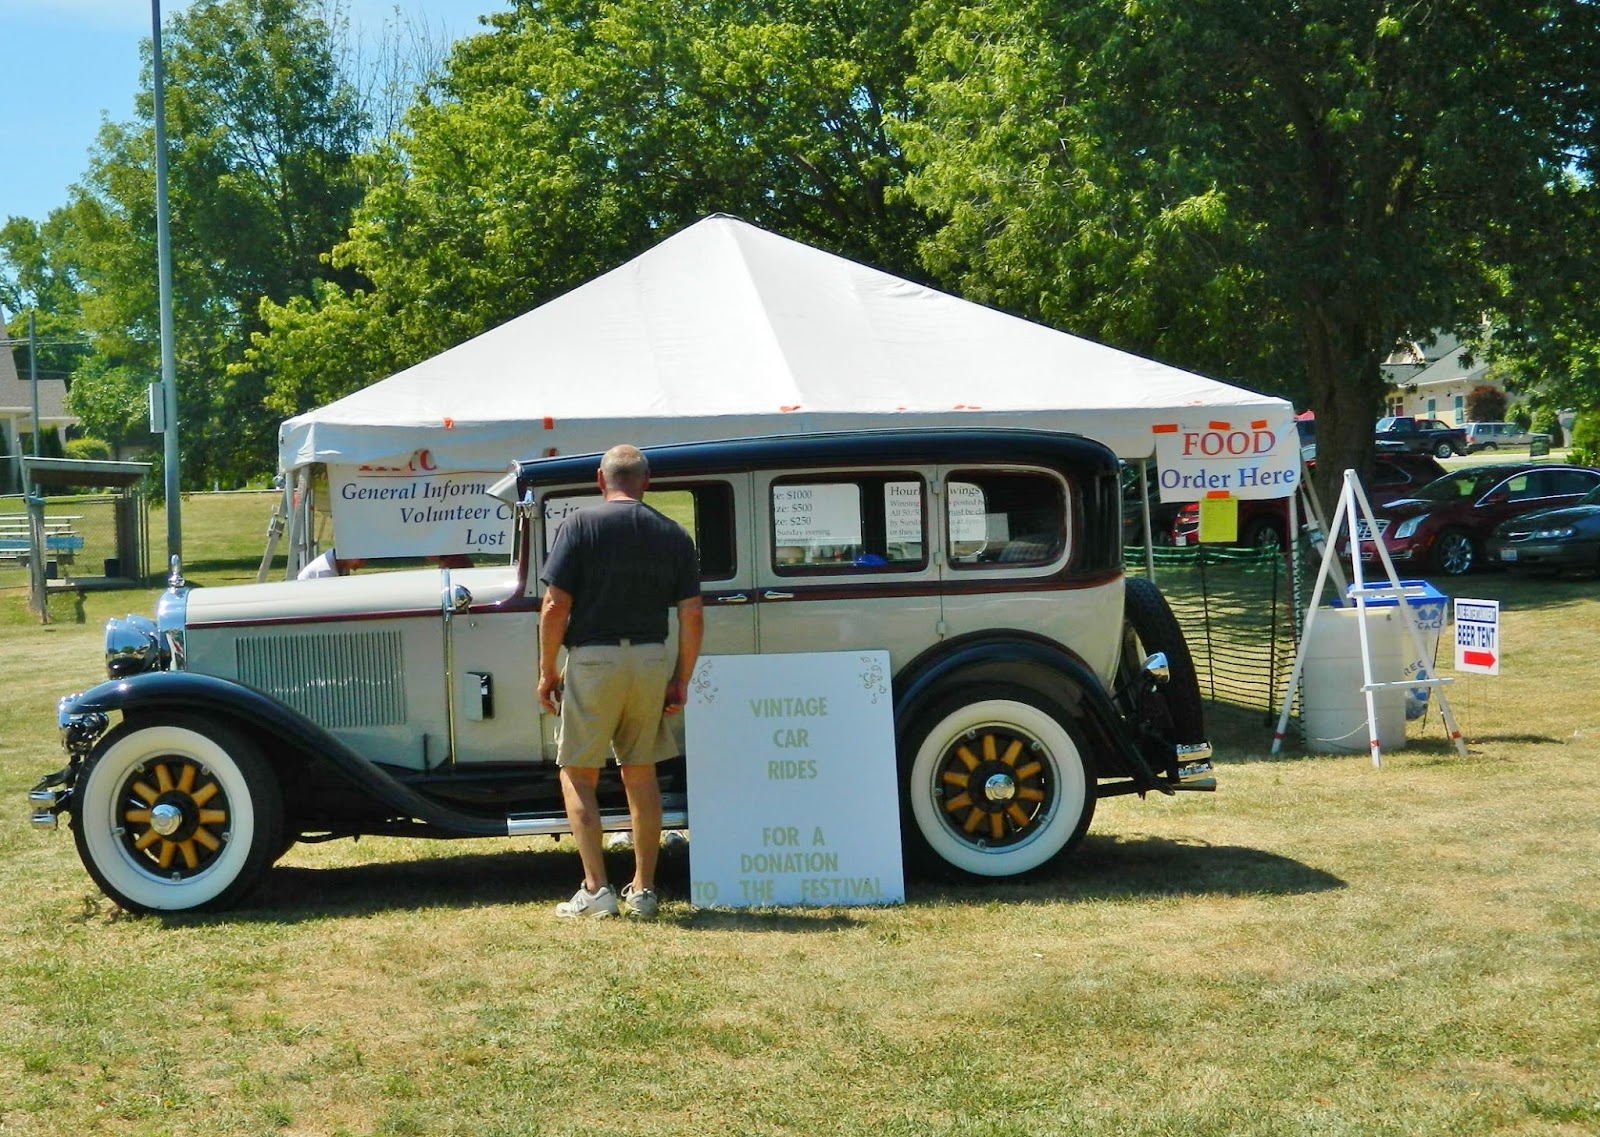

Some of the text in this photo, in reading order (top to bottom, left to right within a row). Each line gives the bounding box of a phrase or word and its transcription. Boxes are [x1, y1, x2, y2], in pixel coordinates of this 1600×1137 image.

[1182, 431, 1276, 456] FOOD
[1161, 467, 1295, 489] Order Here
[342, 480, 489, 503] General Inform
[786, 490, 813, 500] $1000
[949, 486, 981, 498] wings
[400, 506, 491, 524] Volunteer
[791, 503, 813, 513] $500
[789, 516, 812, 526] $250
[466, 528, 506, 545] Lost
[1458, 625, 1495, 648] BEER TENT
[1403, 660, 1425, 677] REC
[750, 697, 828, 718] VINTAGE
[773, 728, 809, 748] CAR
[768, 760, 818, 780] RIDES
[763, 826, 825, 847] FOR A
[740, 853, 839, 873] DONATION
[693, 877, 884, 901] TO THE FESTIVAL
